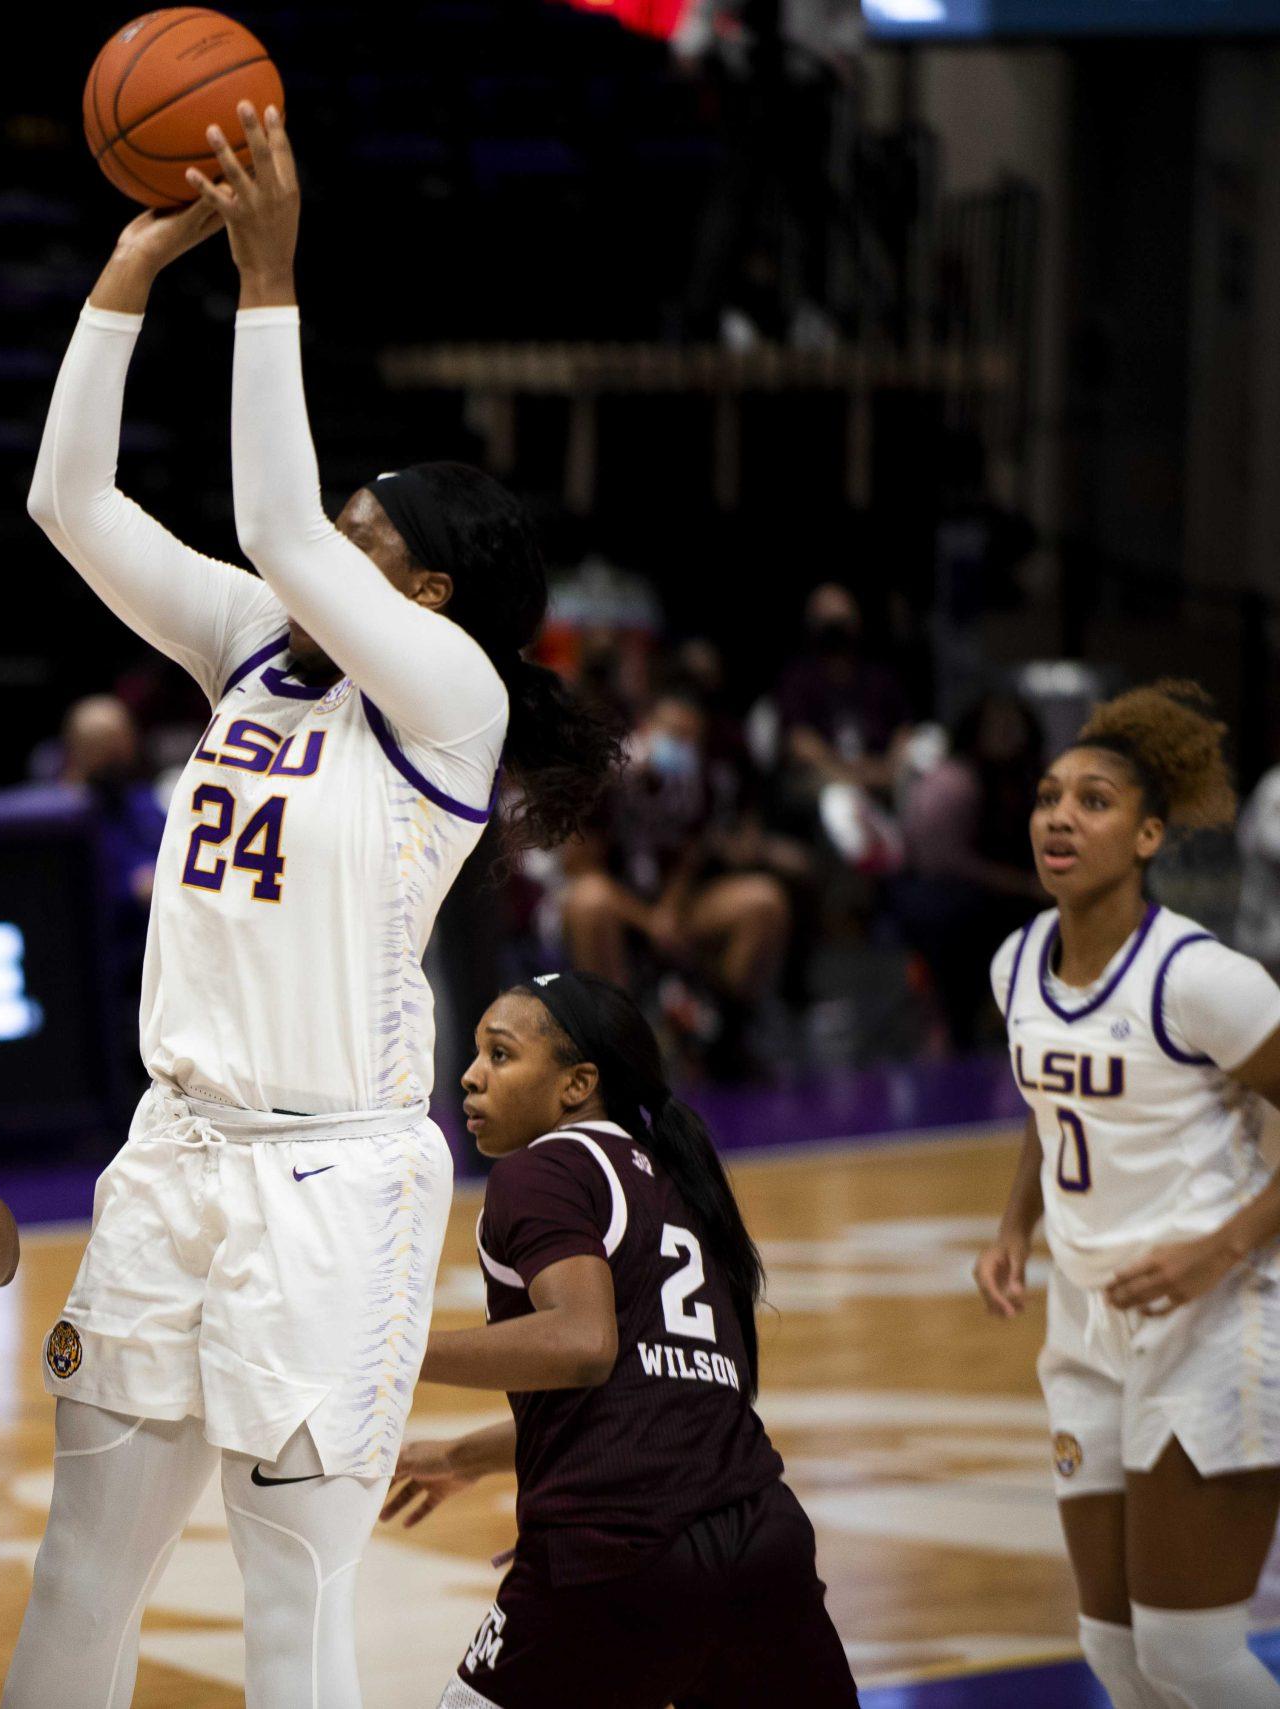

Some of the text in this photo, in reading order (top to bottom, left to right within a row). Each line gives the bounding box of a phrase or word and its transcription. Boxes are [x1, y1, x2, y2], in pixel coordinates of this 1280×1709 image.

[193, 713, 328, 778] LSU
[180, 783, 288, 904] 24
[1015, 1044, 1125, 1099] LSU
[1057, 1106, 1092, 1193] 0
[660, 1223, 717, 1343] 2
[637, 1342, 740, 1393] WILSON
